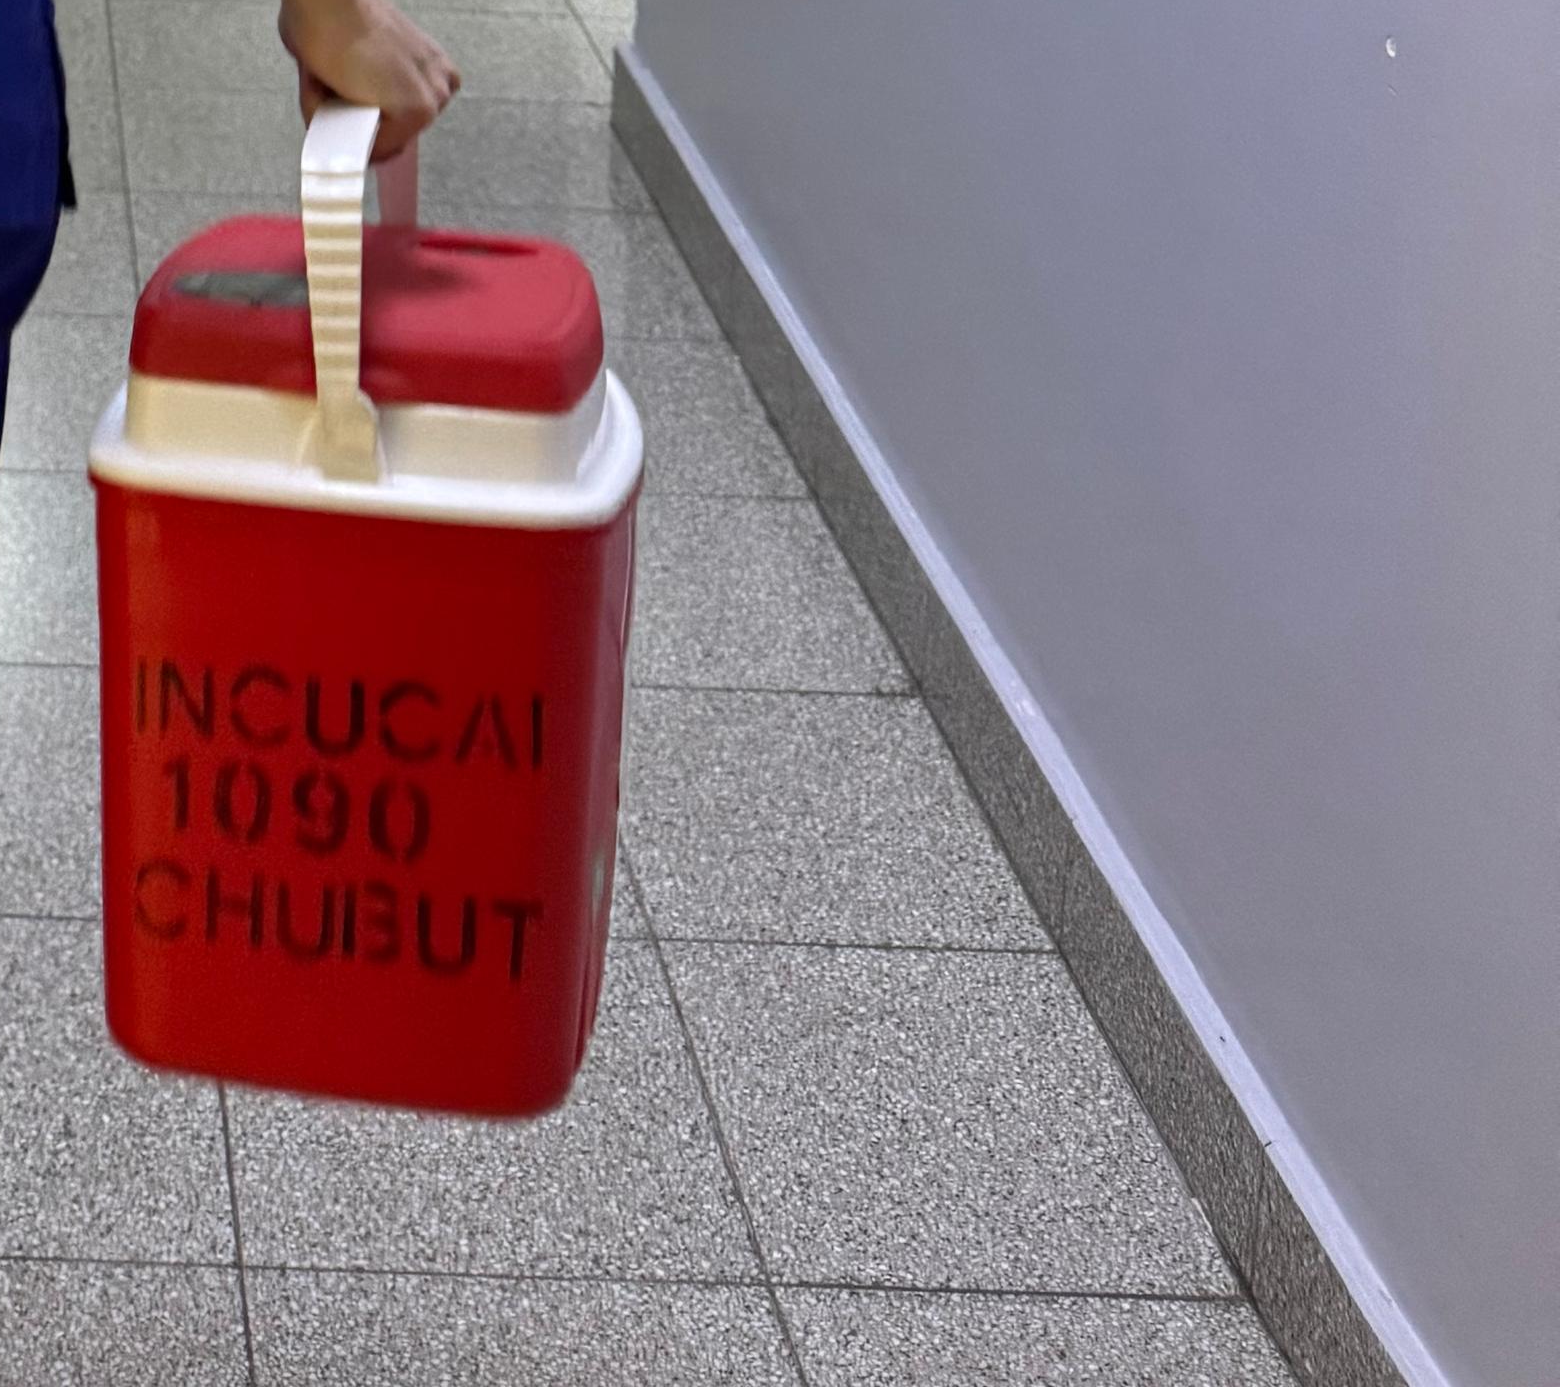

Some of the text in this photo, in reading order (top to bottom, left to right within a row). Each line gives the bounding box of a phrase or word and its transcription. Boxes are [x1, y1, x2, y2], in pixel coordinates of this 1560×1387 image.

[135, 656, 544, 770] INCUCAI
[163, 754, 432, 864] 1090
[134, 859, 543, 982] CHUBUT
